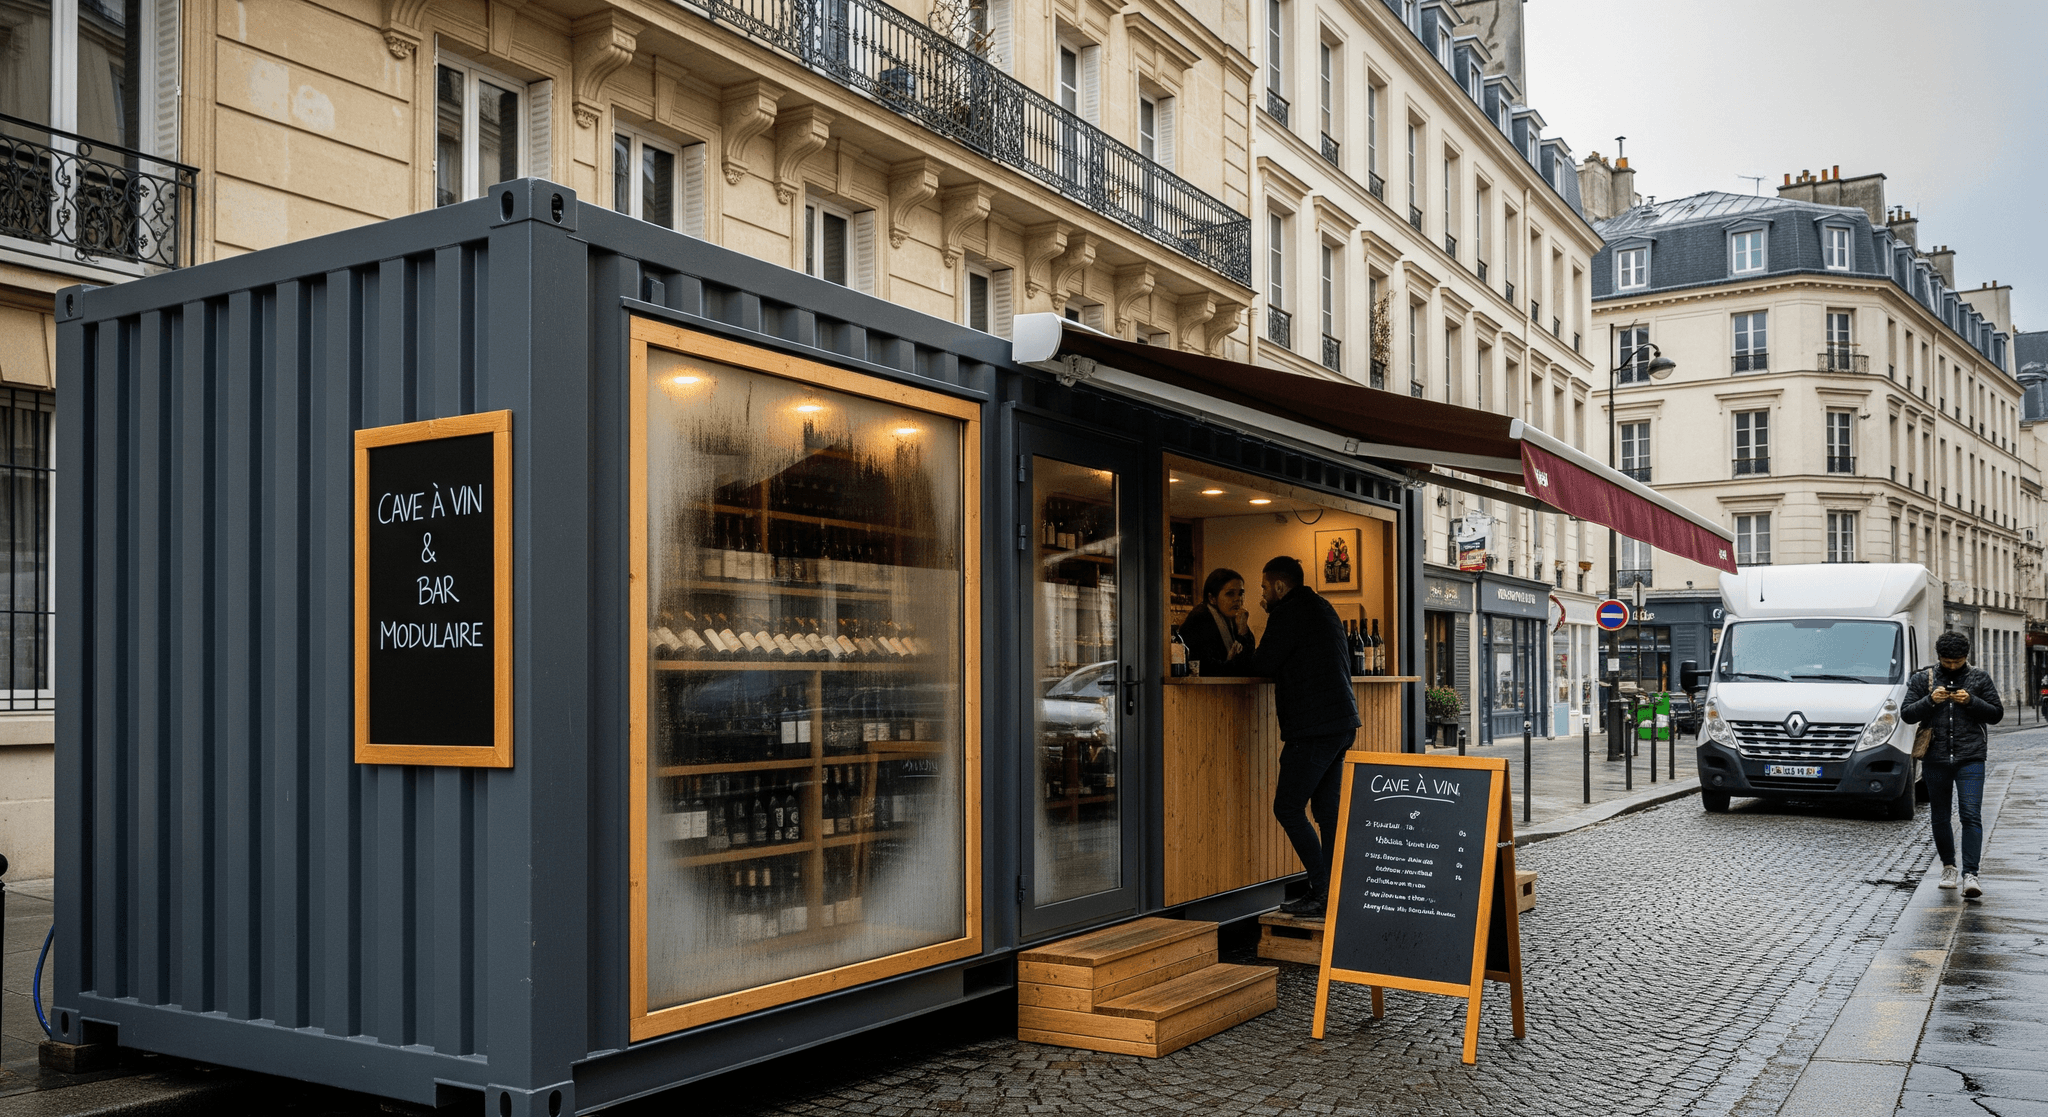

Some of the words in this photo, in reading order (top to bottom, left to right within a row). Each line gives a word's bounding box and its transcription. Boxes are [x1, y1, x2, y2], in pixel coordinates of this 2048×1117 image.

[378, 492, 425, 525] CAVE
[431, 482, 446, 519] À
[450, 484, 482, 516] VIN
[421, 532, 437, 563] &
[416, 575, 460, 606] BAR
[380, 620, 484, 650] MODULAIRE
[1370, 774, 1410, 793] CAVE
[1415, 772, 1428, 794] À
[1433, 778, 1461, 797] VIN
